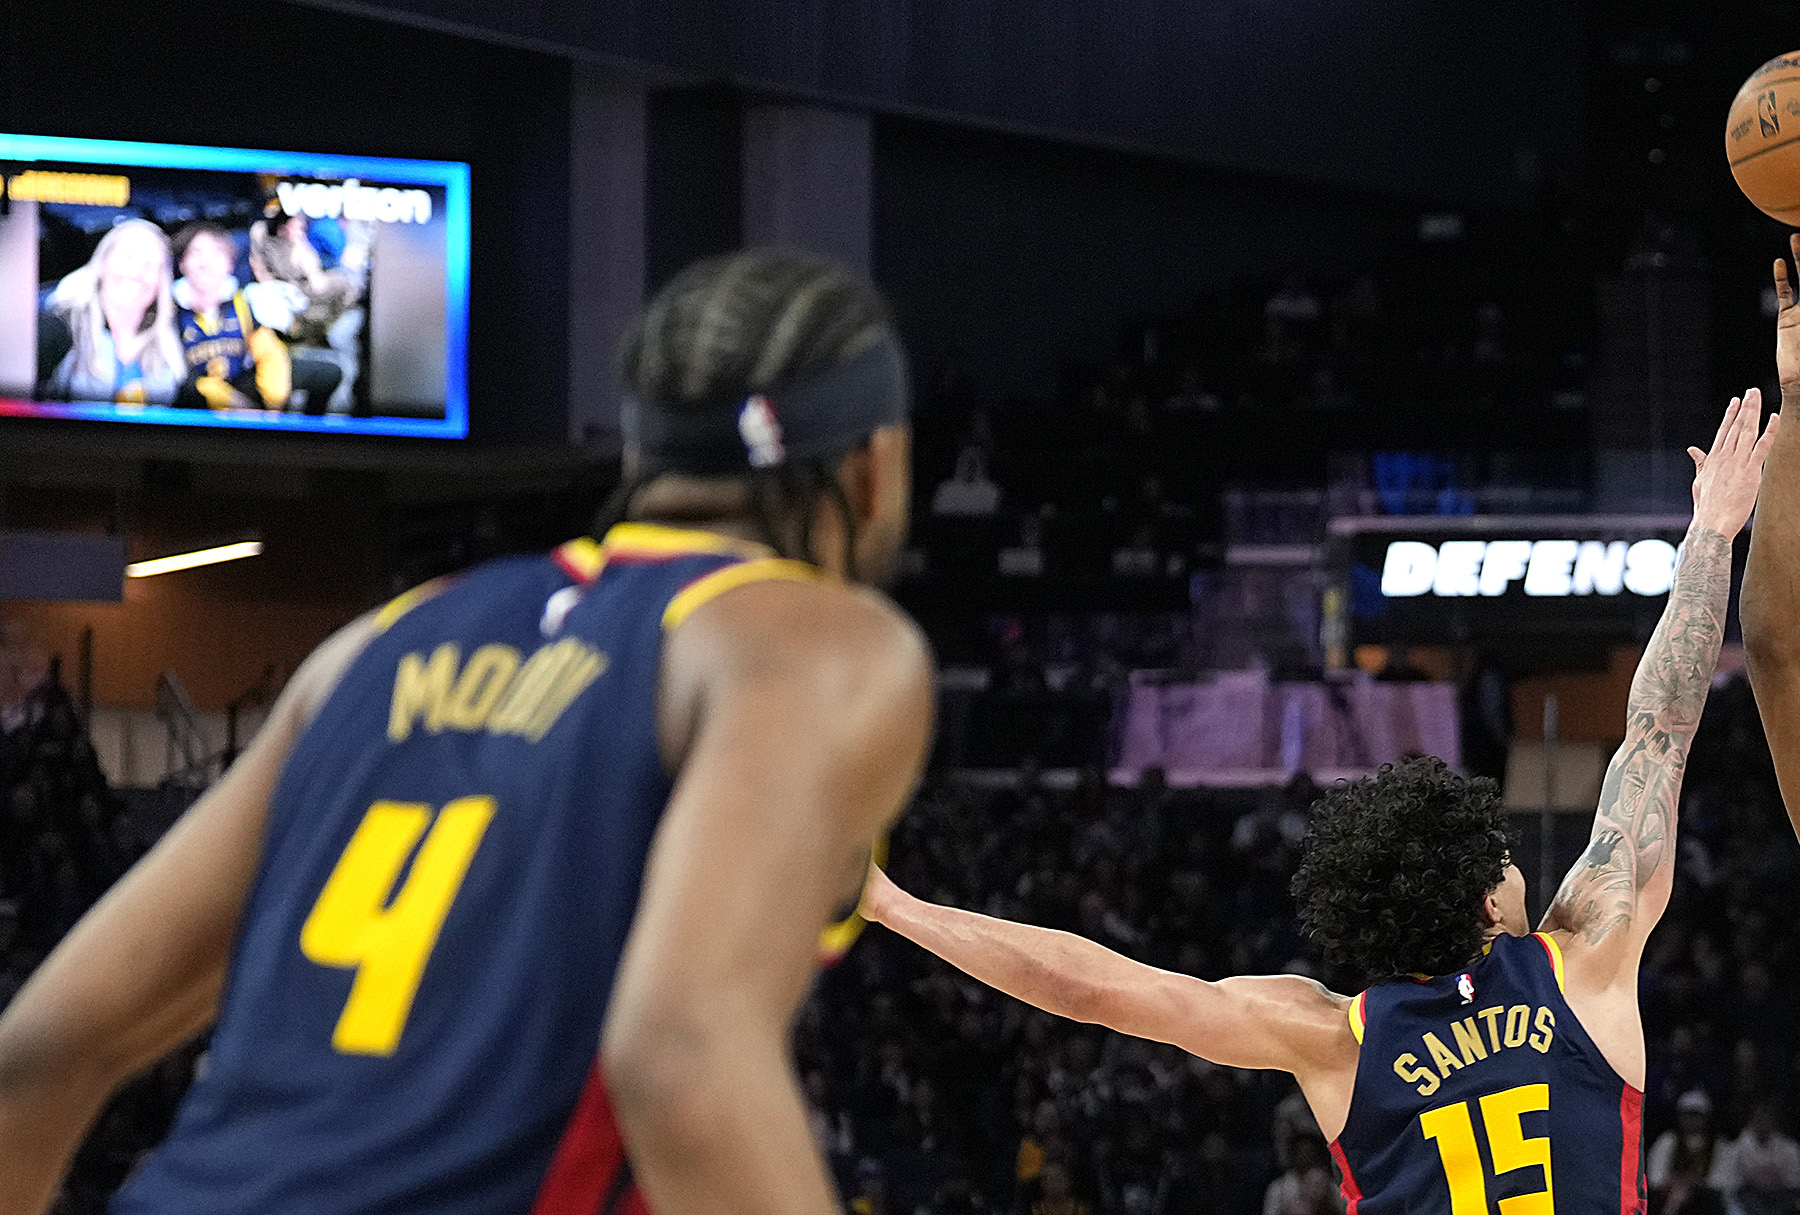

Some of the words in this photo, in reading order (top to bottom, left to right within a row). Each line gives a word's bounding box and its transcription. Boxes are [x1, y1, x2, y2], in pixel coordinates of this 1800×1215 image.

[1381, 540, 1684, 597] DEFENS
[300, 795, 498, 1057] 4
[1393, 1005, 1556, 1096] SANTOS
